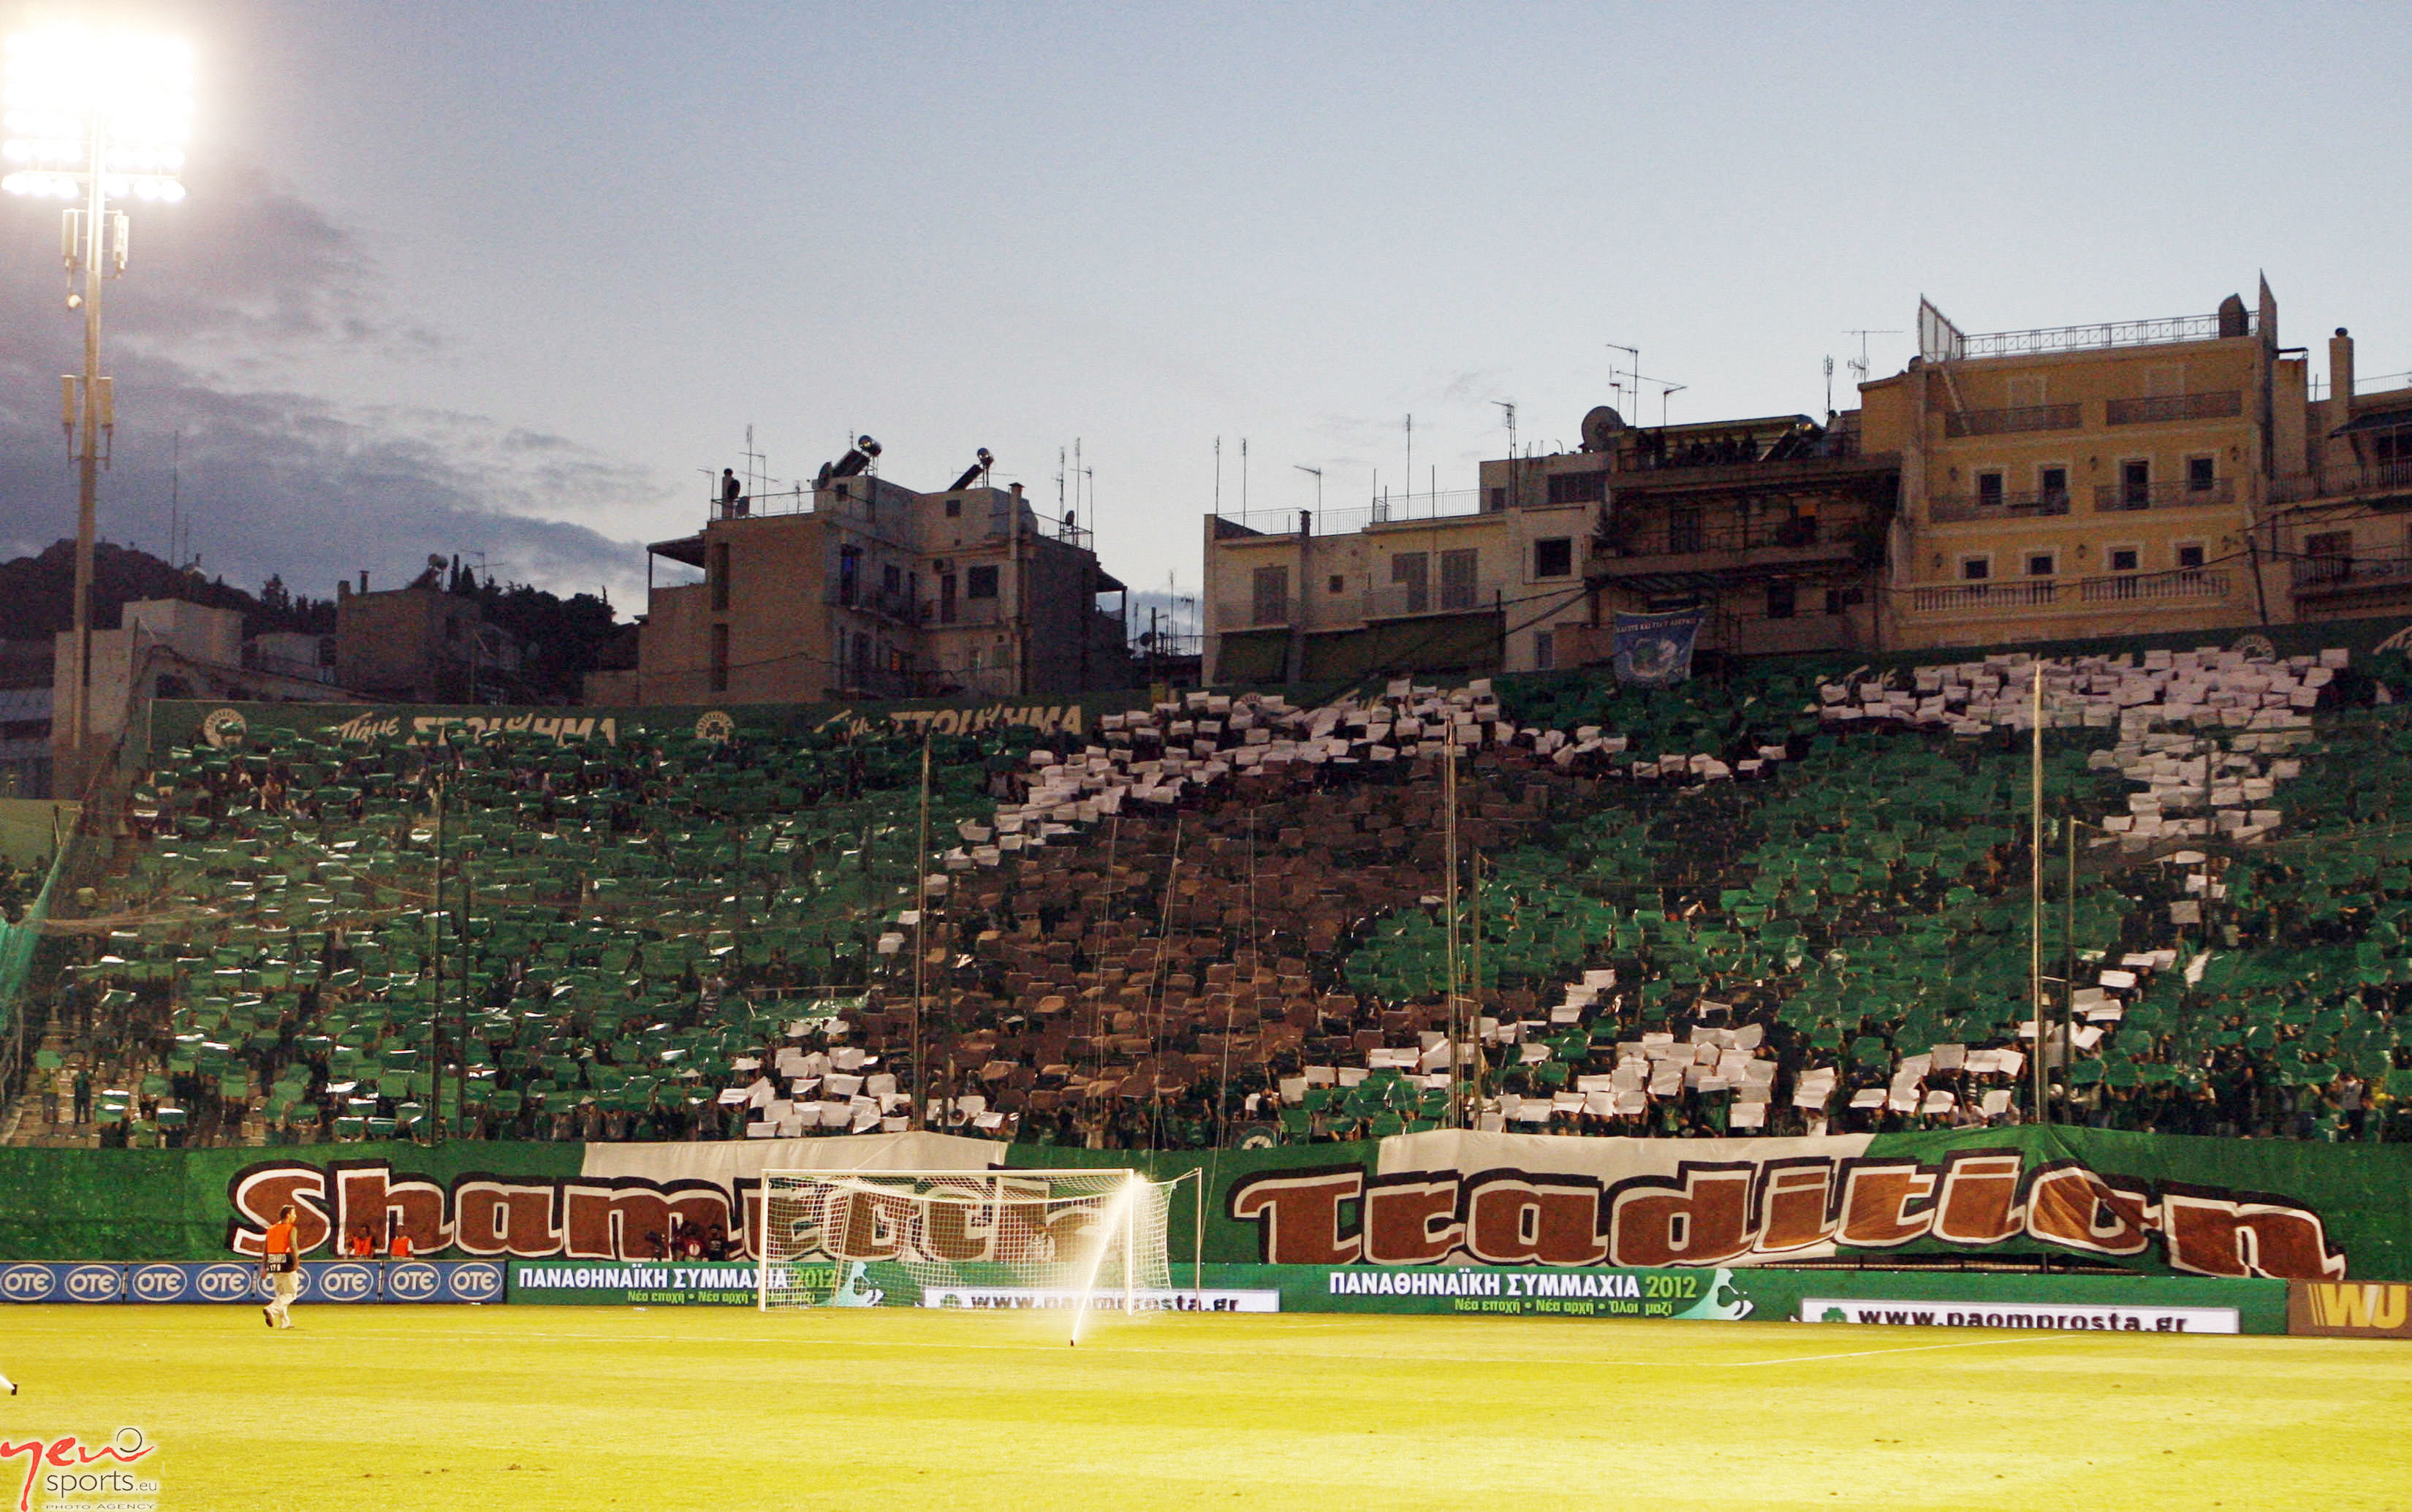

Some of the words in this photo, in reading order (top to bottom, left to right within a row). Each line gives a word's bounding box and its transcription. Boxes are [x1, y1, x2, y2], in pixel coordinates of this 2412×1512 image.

[1225, 1149, 2348, 1280] Tradition
[518, 1263, 668, 1288] ΠΑΝΑΘΗΝΑΪΚΗ
[792, 1269, 837, 1288] 2012
[1330, 1268, 1500, 1296] ΠΑΝΑΘΗΝΑΪΚΗ
[1506, 1274, 1640, 1298] ΣΥΜΜΑΧΙΑ
[1645, 1276, 1697, 1299] 2012
[627, 1291, 648, 1302] Νέα
[651, 1291, 685, 1304] εποχή
[698, 1291, 720, 1302] Νέα
[722, 1292, 749, 1304] αρχή
[971, 1294, 1239, 1312] www.pamrosta.gr
[1455, 1299, 1479, 1311] Νέα
[1482, 1299, 1521, 1314] εποχή
[1536, 1299, 1562, 1312] Νέα
[1563, 1299, 1594, 1315] αρχή
[1645, 1302, 1673, 1316] μαζί
